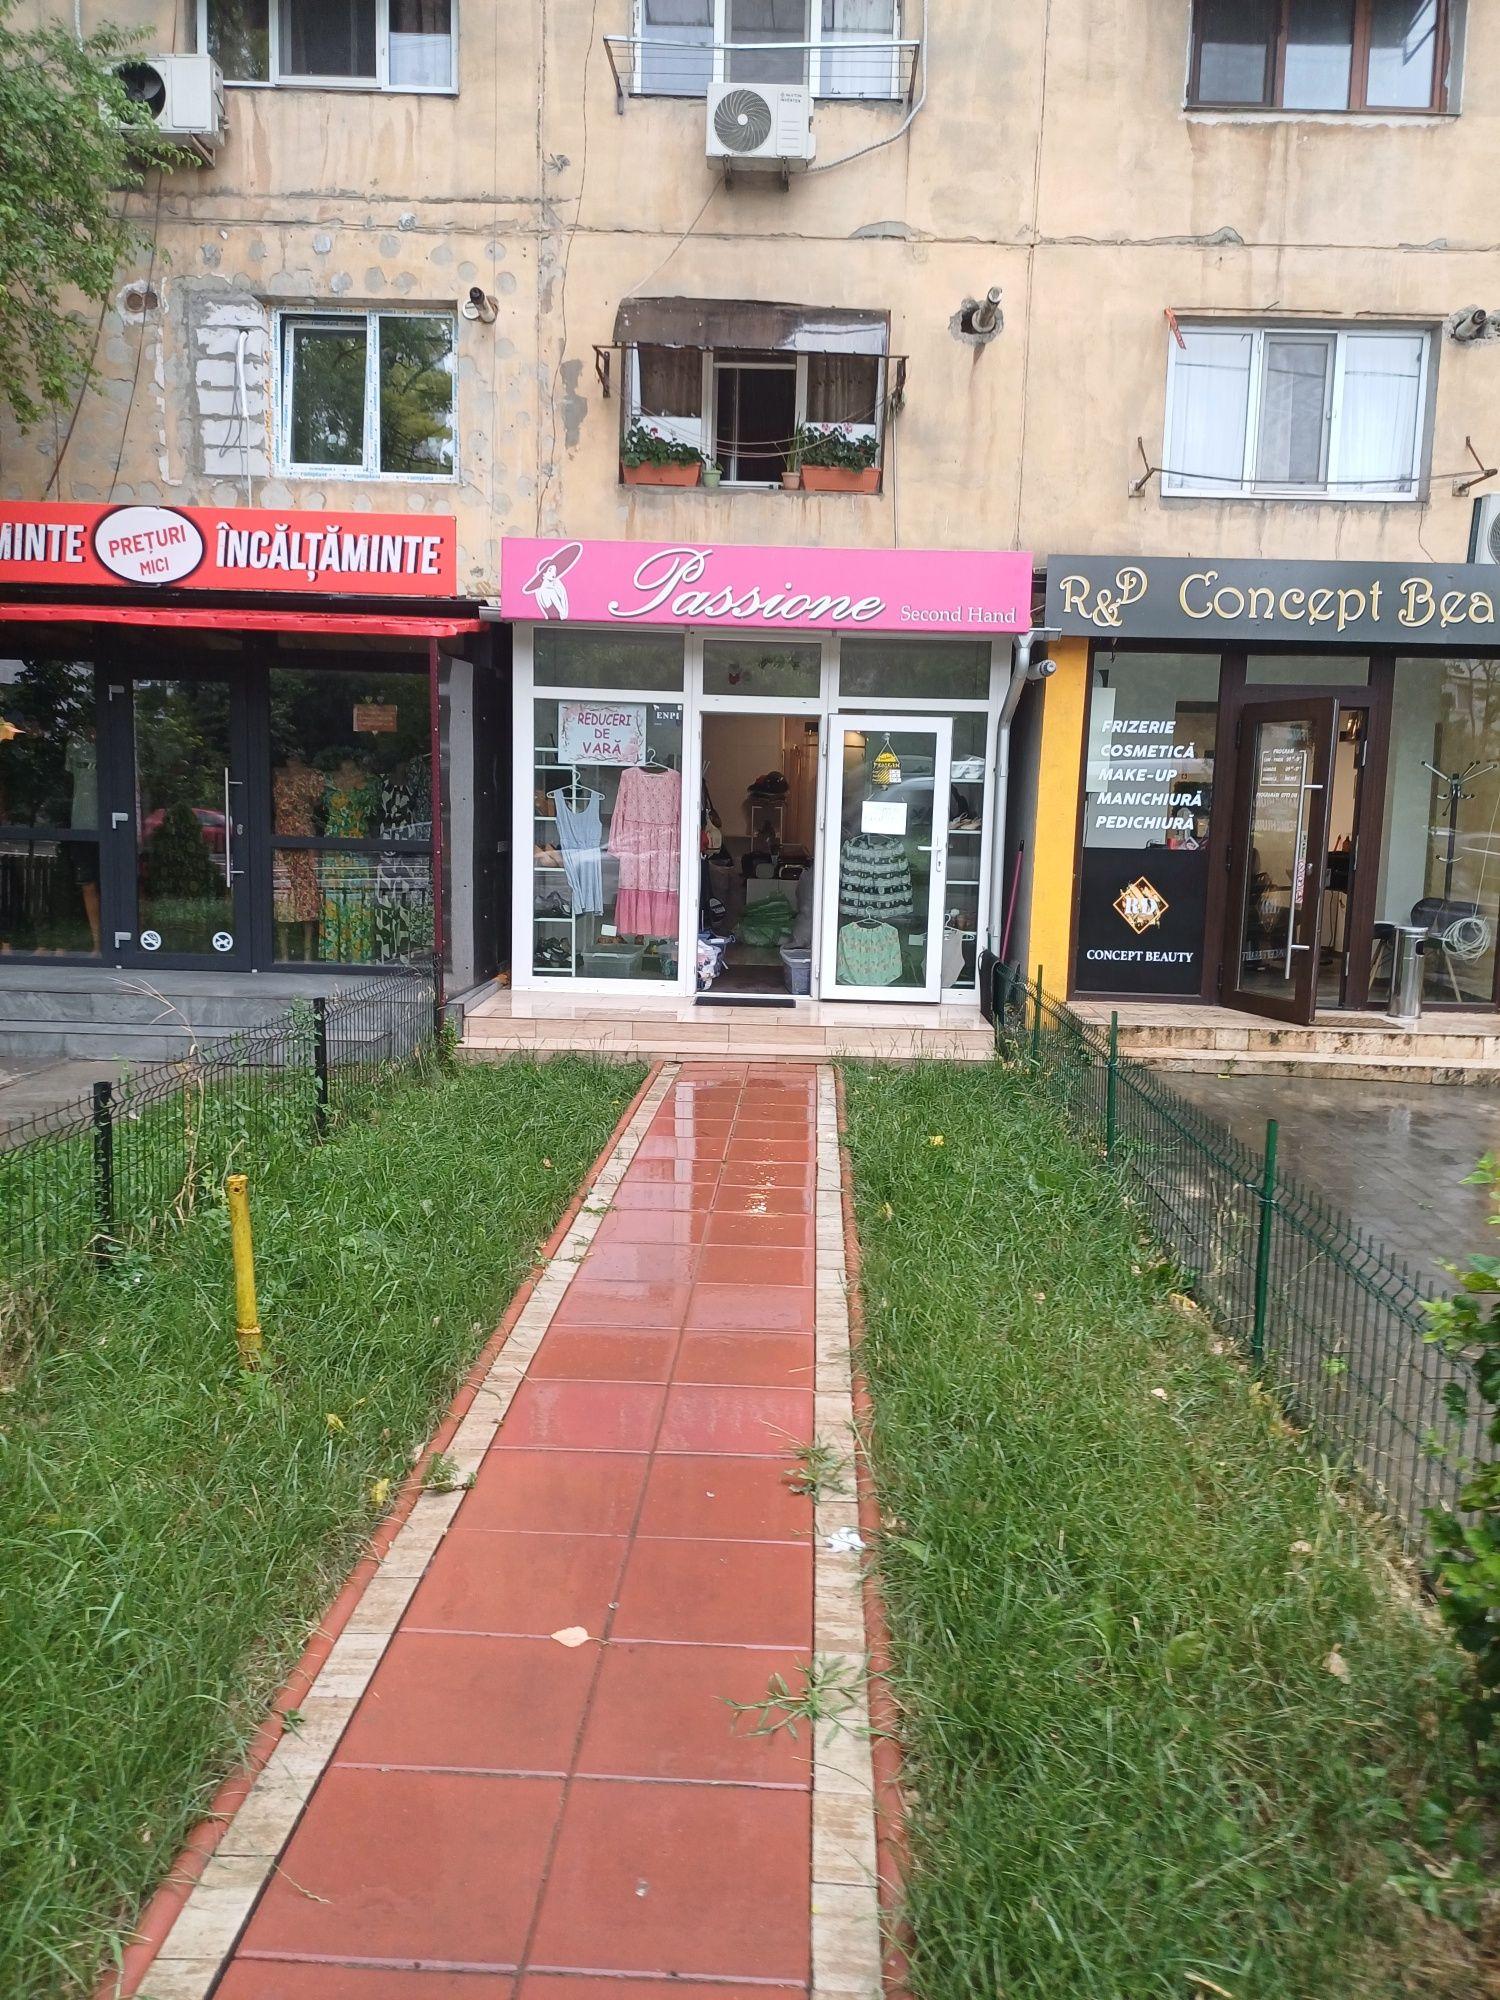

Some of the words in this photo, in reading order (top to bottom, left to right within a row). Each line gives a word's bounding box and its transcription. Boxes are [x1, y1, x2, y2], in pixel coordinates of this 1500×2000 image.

[108, 524, 187, 558] PREȚURI
[215, 521, 443, 582] ÎNCĂLȚĂMINTE
[139, 556, 170, 576] MICI
[607, 547, 886, 622] Passione
[1179, 570, 1383, 632] Concept
[900, 605, 962, 622] Second
[967, 606, 1016, 624] Hand
[577, 712, 632, 727] REDUCERI
[1102, 720, 1176, 734] FRIZERIE
[594, 728, 610, 739] DE
[582, 739, 622, 755] VARĂ
[1100, 742, 1195, 758] COSMETICĂ
[1098, 768, 1178, 782] MAKE-UP
[1096, 790, 1202, 807] MANICHIURĂ
[1095, 814, 1195, 830] PEDICHIURĂ
[1086, 949, 1144, 961] CONCEPT
[1145, 951, 1194, 963] BEAUTY
